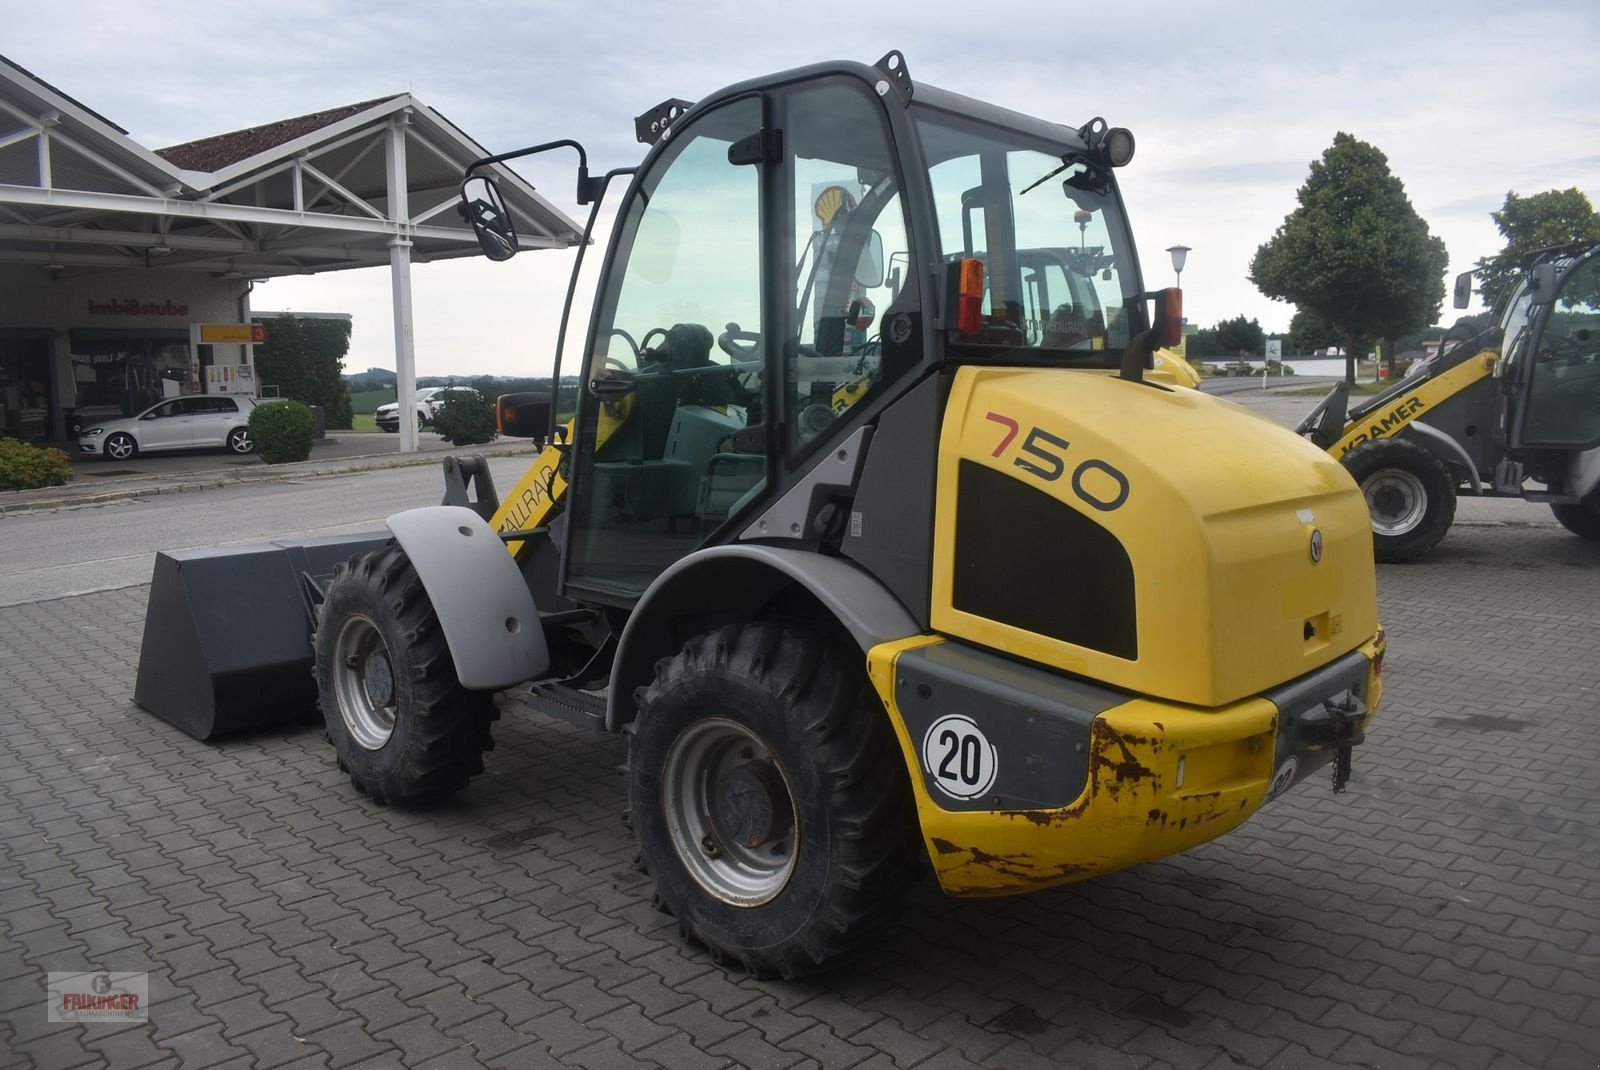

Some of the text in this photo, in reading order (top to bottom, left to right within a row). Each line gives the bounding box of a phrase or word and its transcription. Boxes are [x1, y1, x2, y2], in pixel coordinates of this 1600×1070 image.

[88, 298, 189, 316] Imbißstube
[255, 328, 265, 340] 3
[985, 411, 1130, 512] 750
[938, 729, 982, 786] 20
